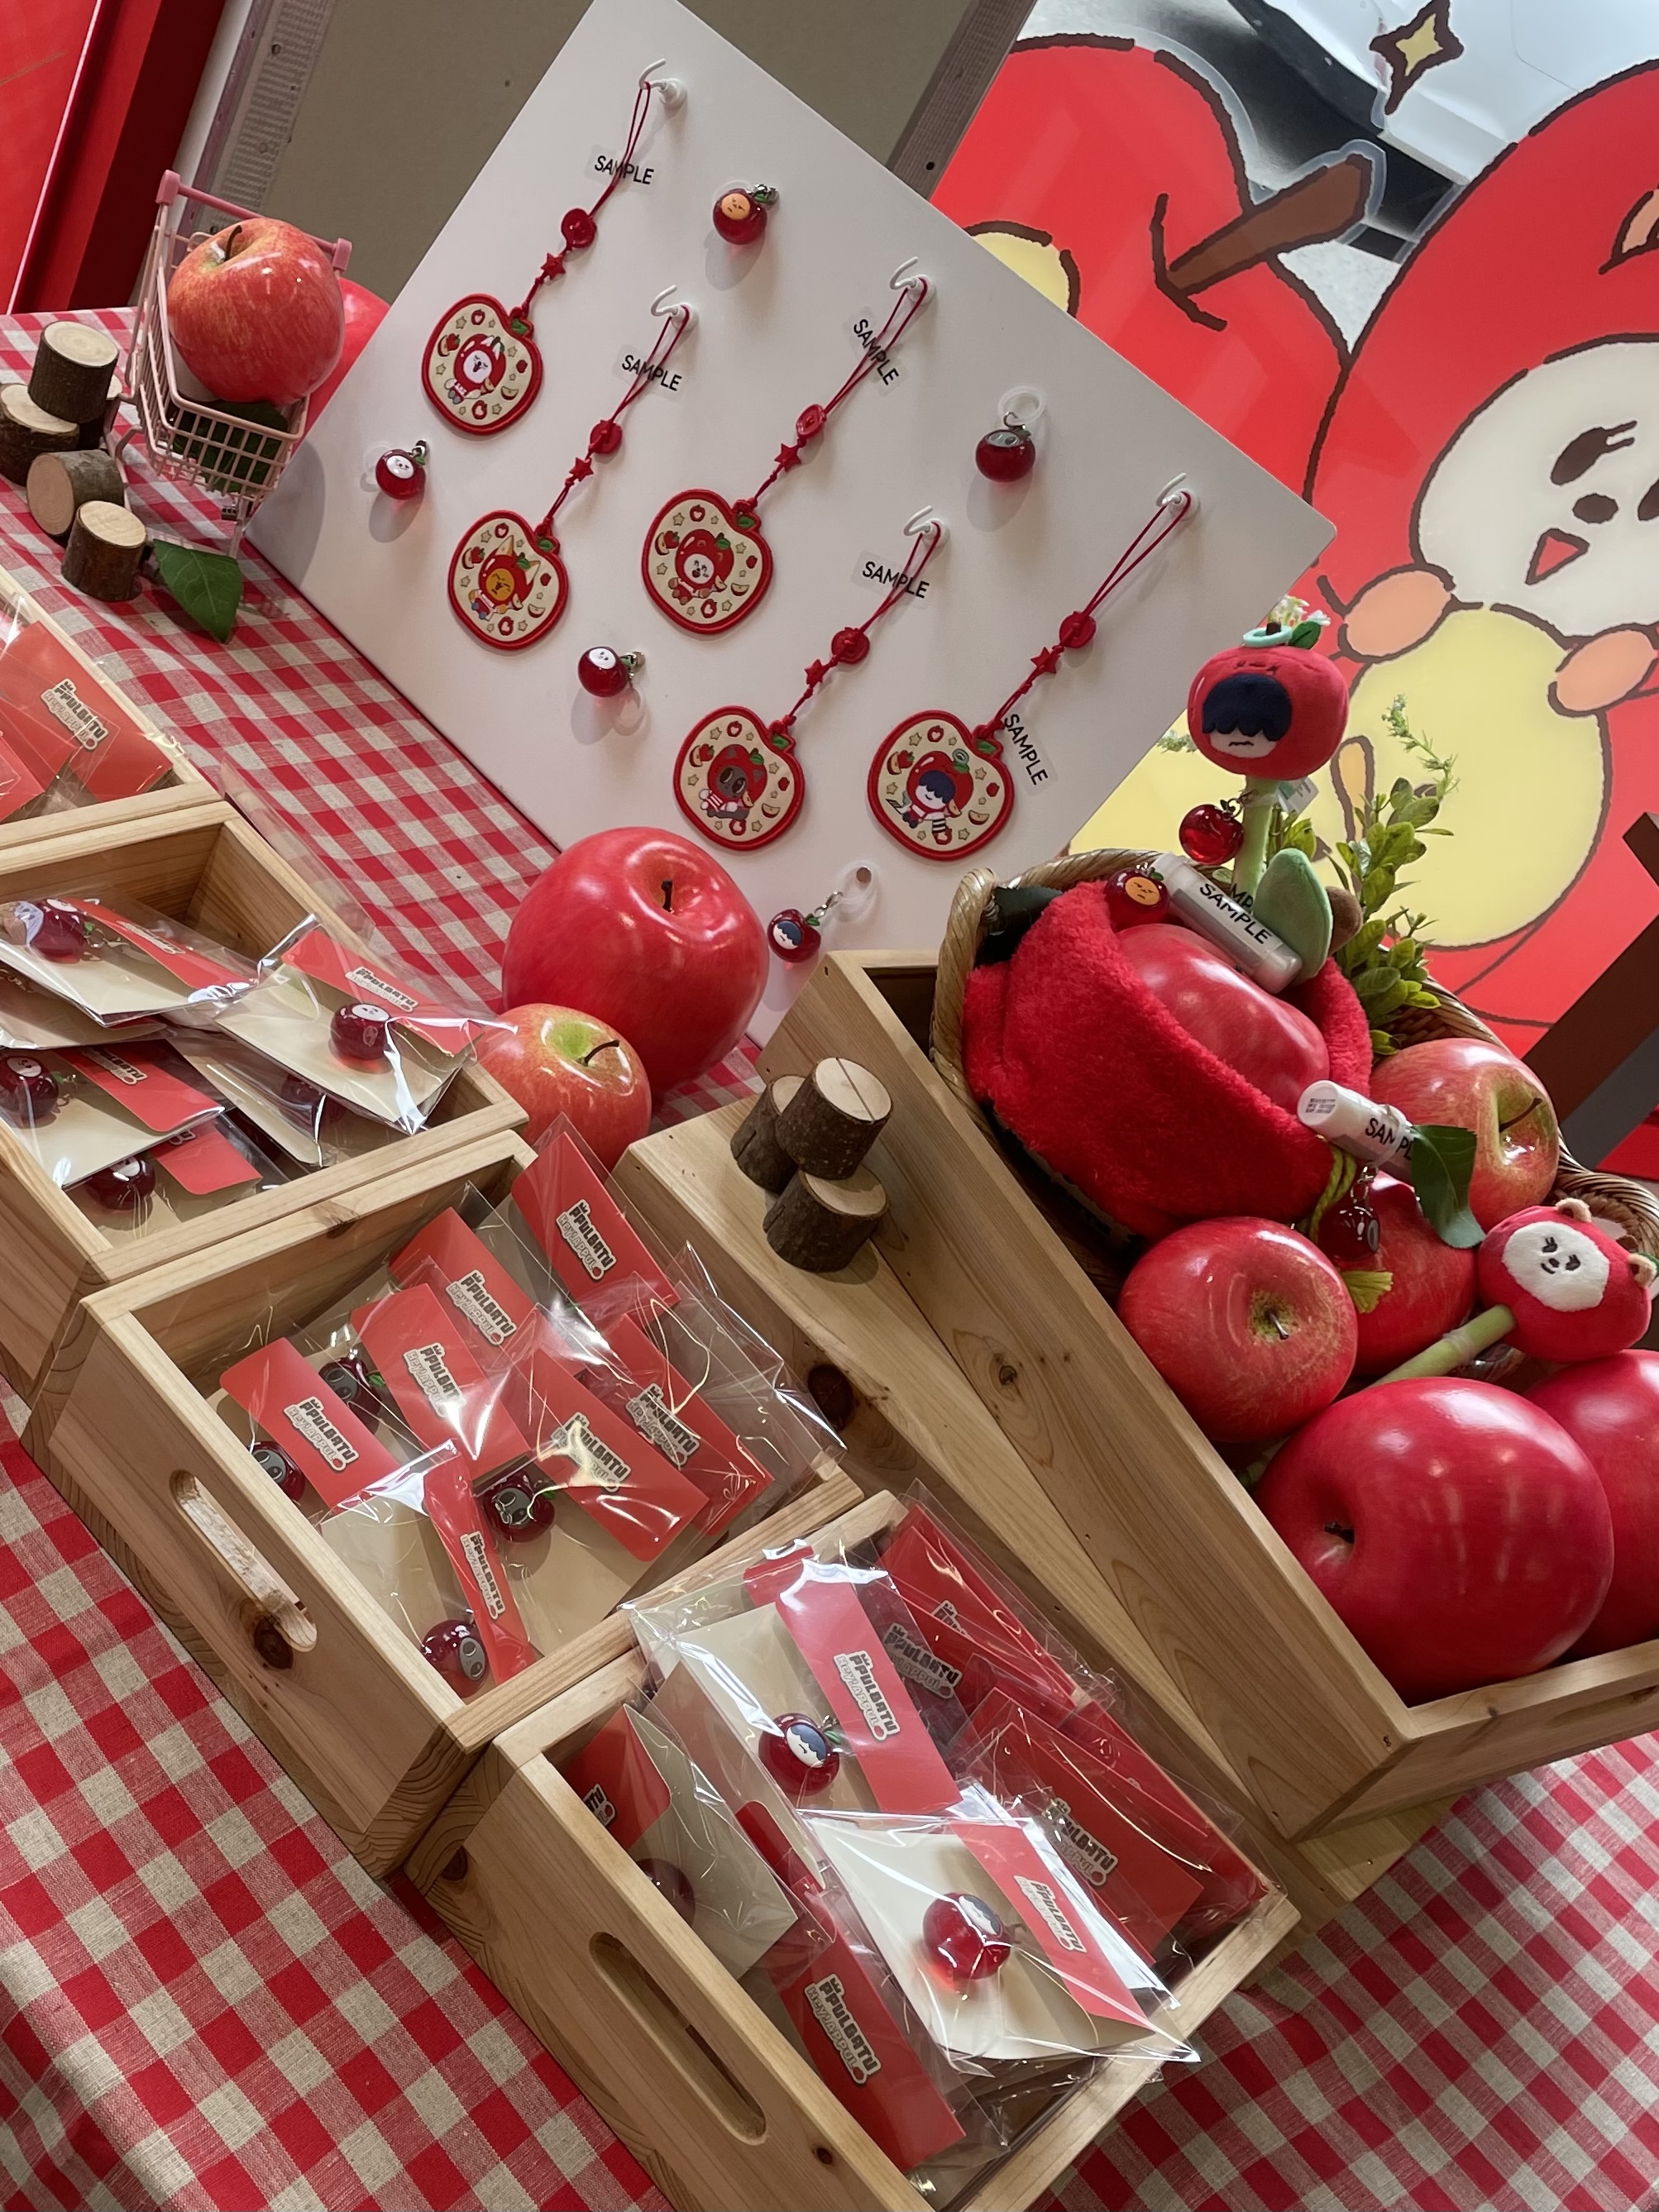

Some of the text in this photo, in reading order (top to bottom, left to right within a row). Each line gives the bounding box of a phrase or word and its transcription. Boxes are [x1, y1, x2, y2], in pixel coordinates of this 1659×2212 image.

[622, 355, 682, 391] SAMPLE
[853, 318, 899, 385] SAMPLE
[863, 561, 930, 599] SAMPLE
[1004, 714, 1049, 786] SAMPLE
[1199, 883, 1272, 944] SAMPLE
[569, 1206, 614, 1268] PPULBATU
[461, 1276, 514, 1334] PPULBATU
[299, 1402, 356, 1460] PPULBATU
[849, 1655, 897, 1731] PPULBATU
[819, 1981, 878, 2071] PPULBATU
